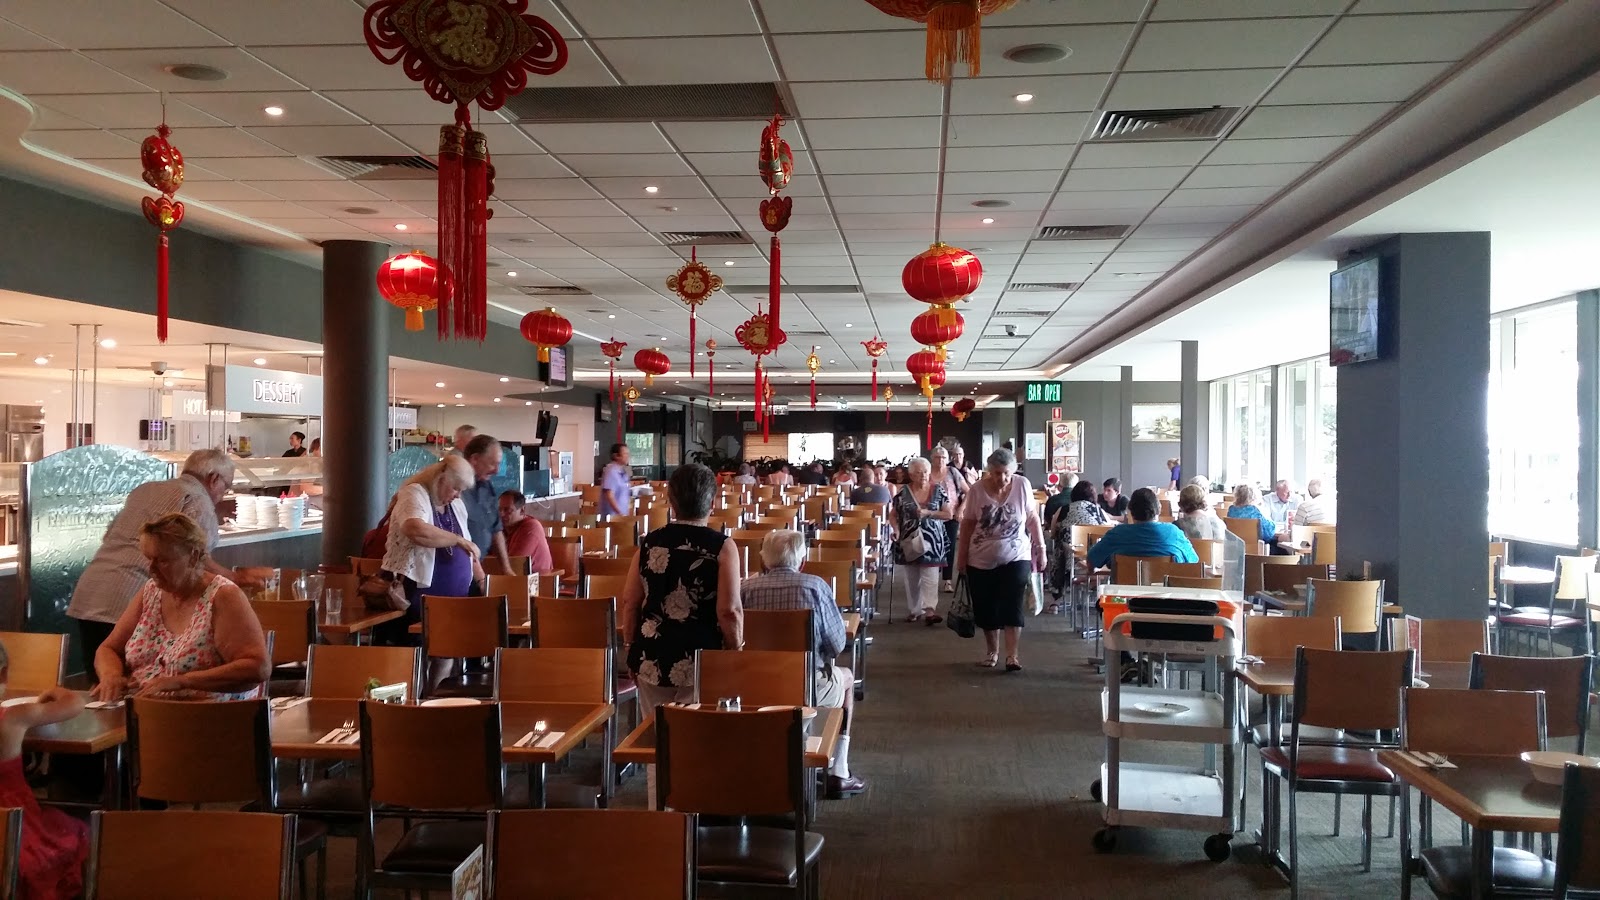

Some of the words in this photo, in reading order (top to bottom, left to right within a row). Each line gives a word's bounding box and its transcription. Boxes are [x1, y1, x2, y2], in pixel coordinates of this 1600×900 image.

[682, 270, 706, 294] 福
[253, 379, 304, 404] DESSERT
[1028, 383, 1042, 402] BAR
[1044, 383, 1061, 402] OPEN
[183, 398, 202, 415] HOT
